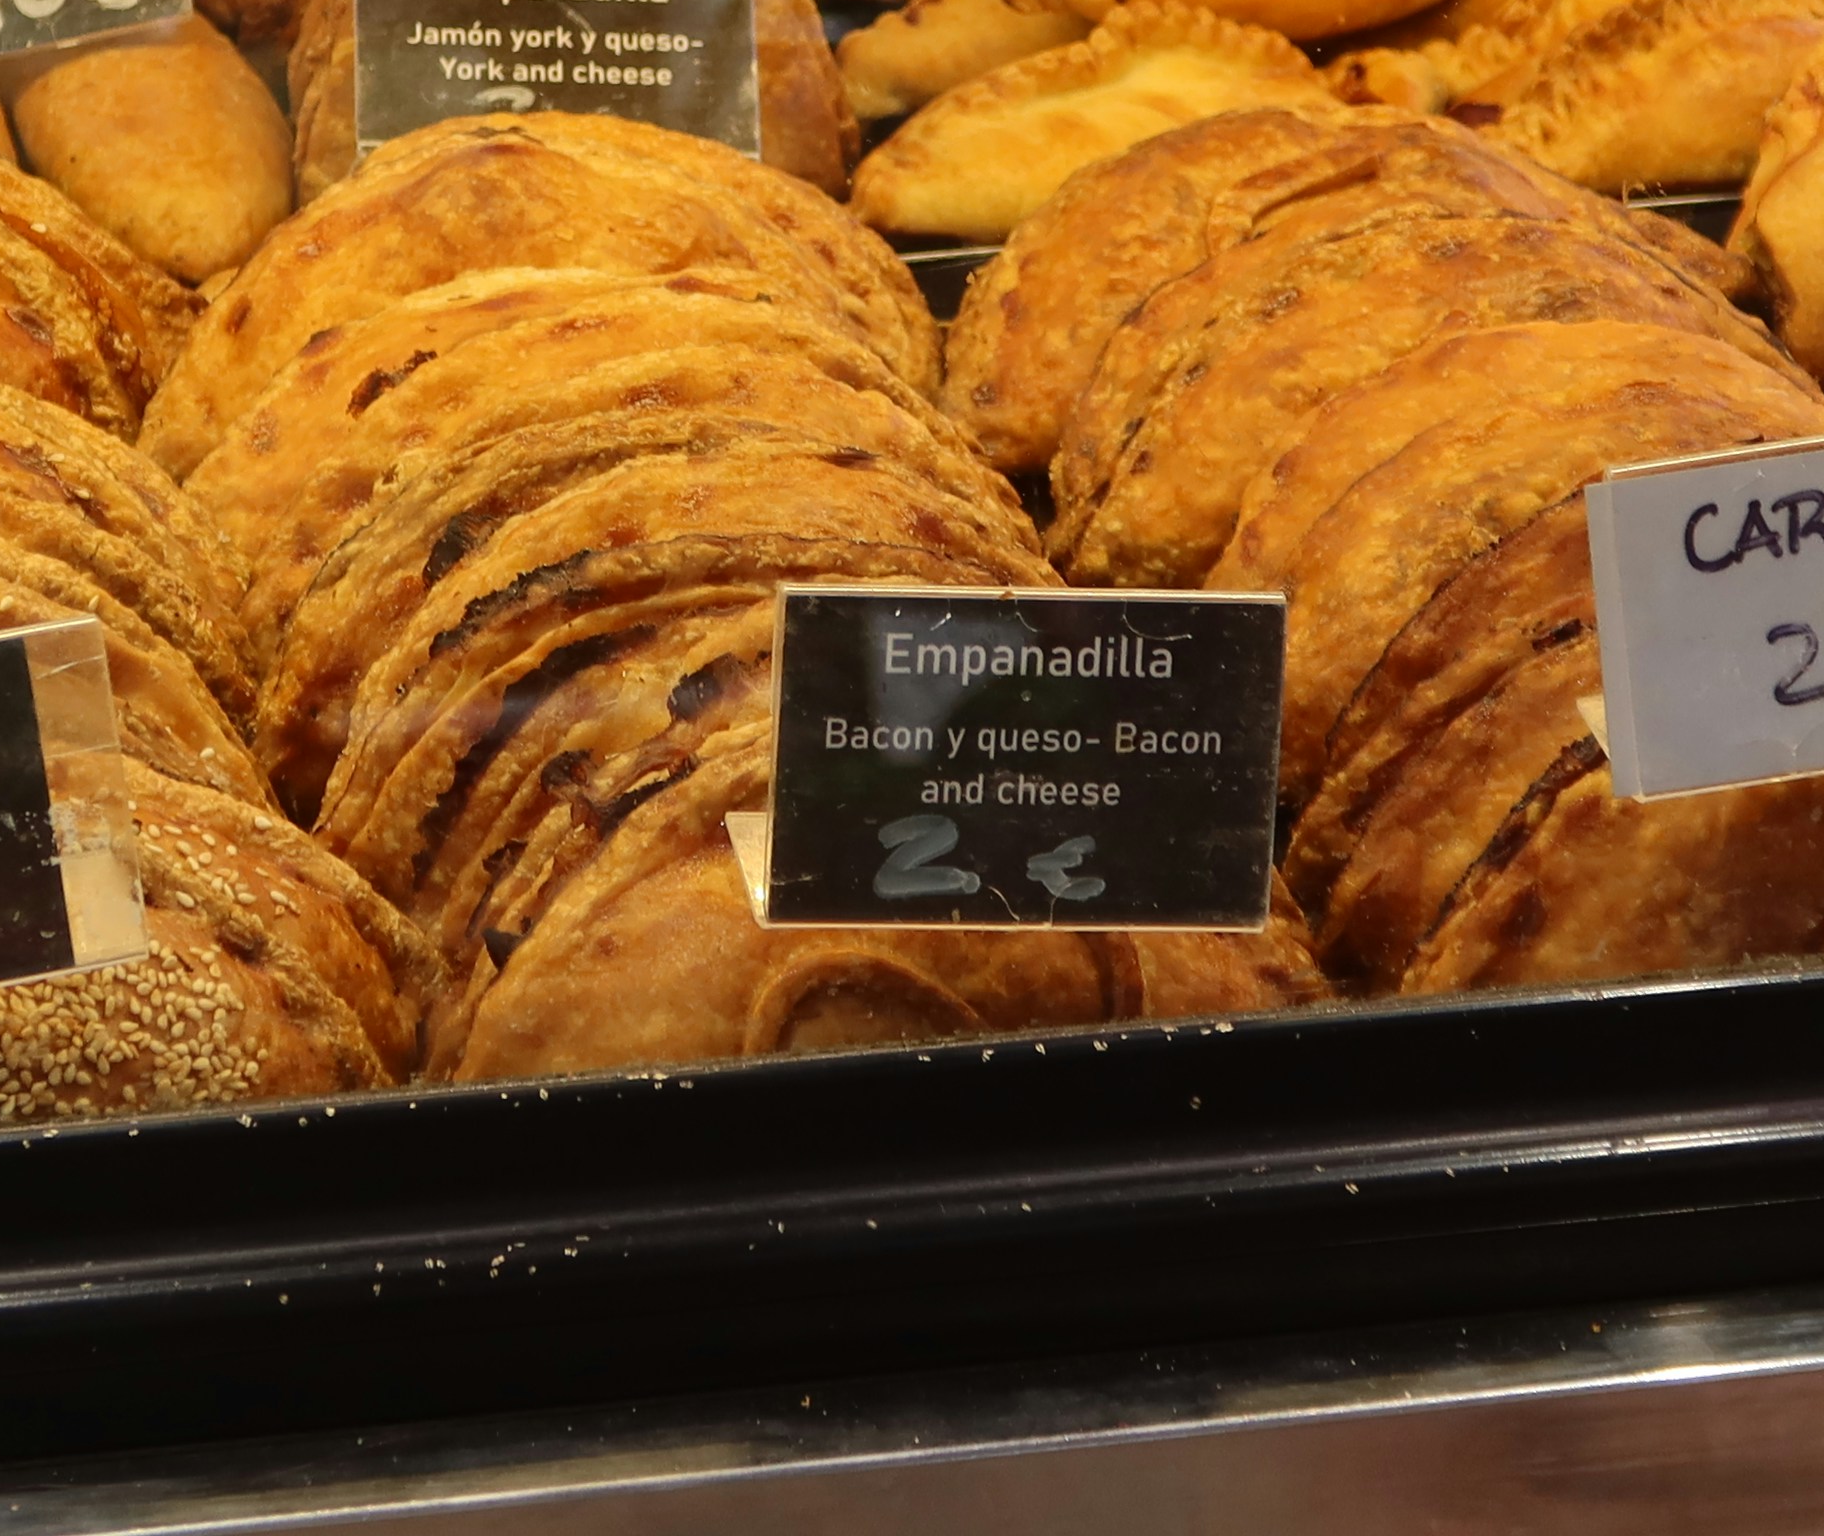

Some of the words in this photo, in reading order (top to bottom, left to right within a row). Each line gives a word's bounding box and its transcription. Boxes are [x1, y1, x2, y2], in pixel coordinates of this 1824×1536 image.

[407, 21, 501, 48] Jamón
[511, 25, 573, 52] york
[581, 32, 597, 54] y
[604, 32, 704, 56] queso-
[439, 56, 504, 82] York
[513, 58, 564, 83] and
[573, 60, 673, 86] cheese
[884, 631, 1174, 686] Empanadilla
[825, 718, 934, 753] Bacon
[947, 725, 966, 759] y
[976, 722, 1101, 760] queso-
[1114, 721, 1223, 755] Bacon
[920, 774, 984, 805] and
[997, 774, 1121, 807] cheese
[873, 812, 980, 900] 2
